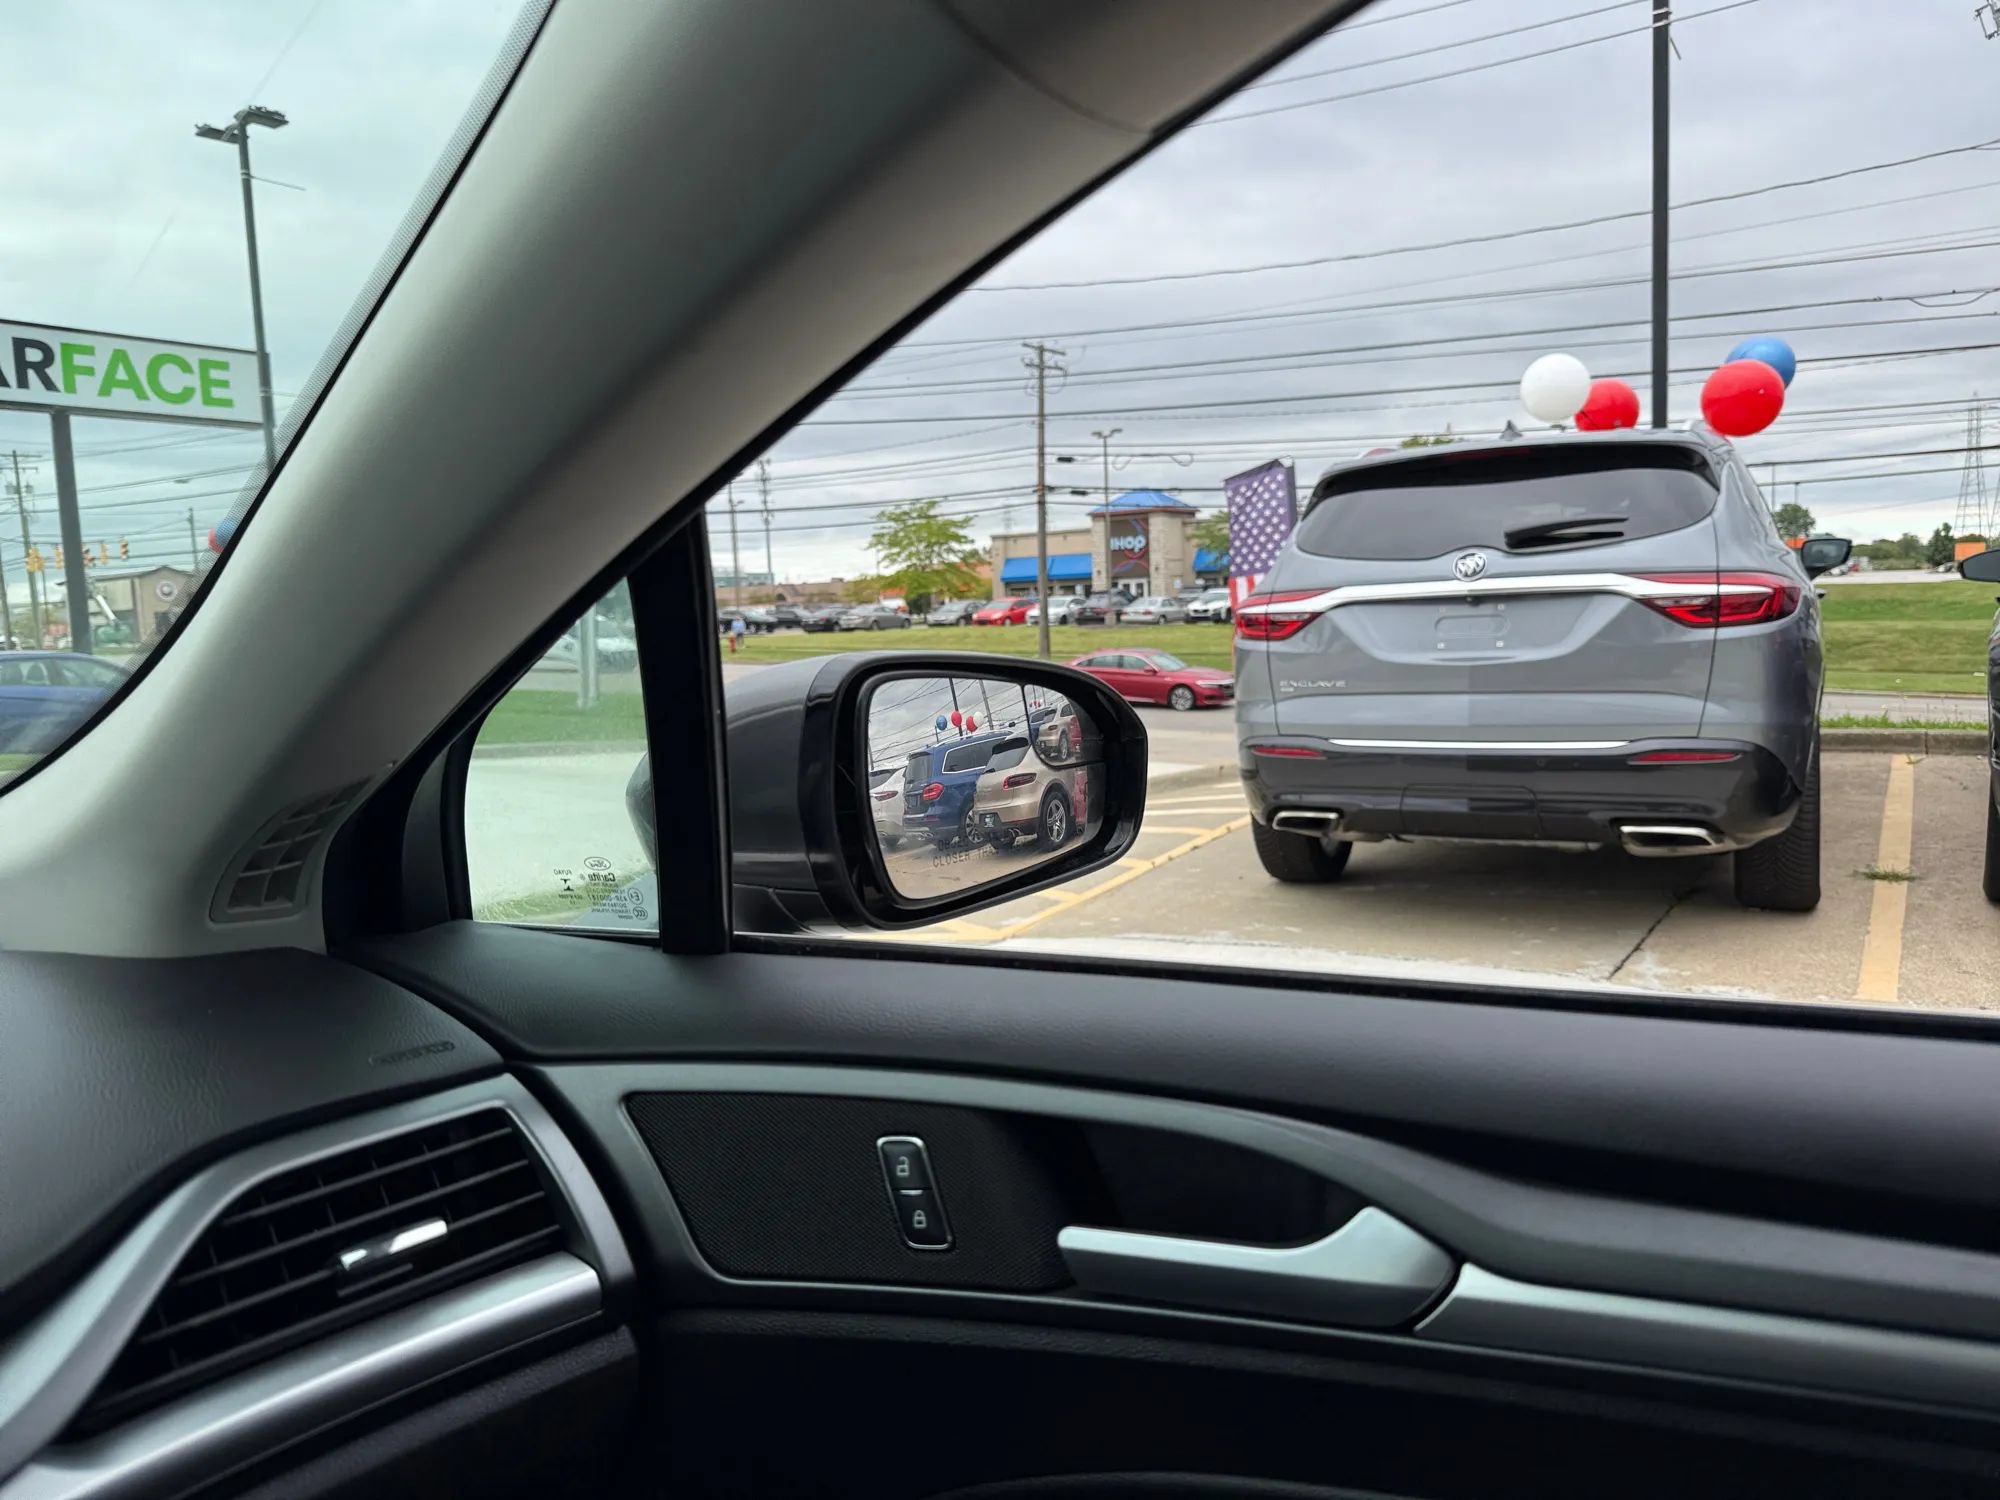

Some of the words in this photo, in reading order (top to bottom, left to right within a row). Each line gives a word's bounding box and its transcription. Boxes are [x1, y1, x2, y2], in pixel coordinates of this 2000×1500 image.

[0, 337, 234, 408] RFACE
[1110, 535, 1147, 552] IHOP
[1280, 680, 1346, 688] ENCLAVE
[932, 851, 970, 868] CLOSER
